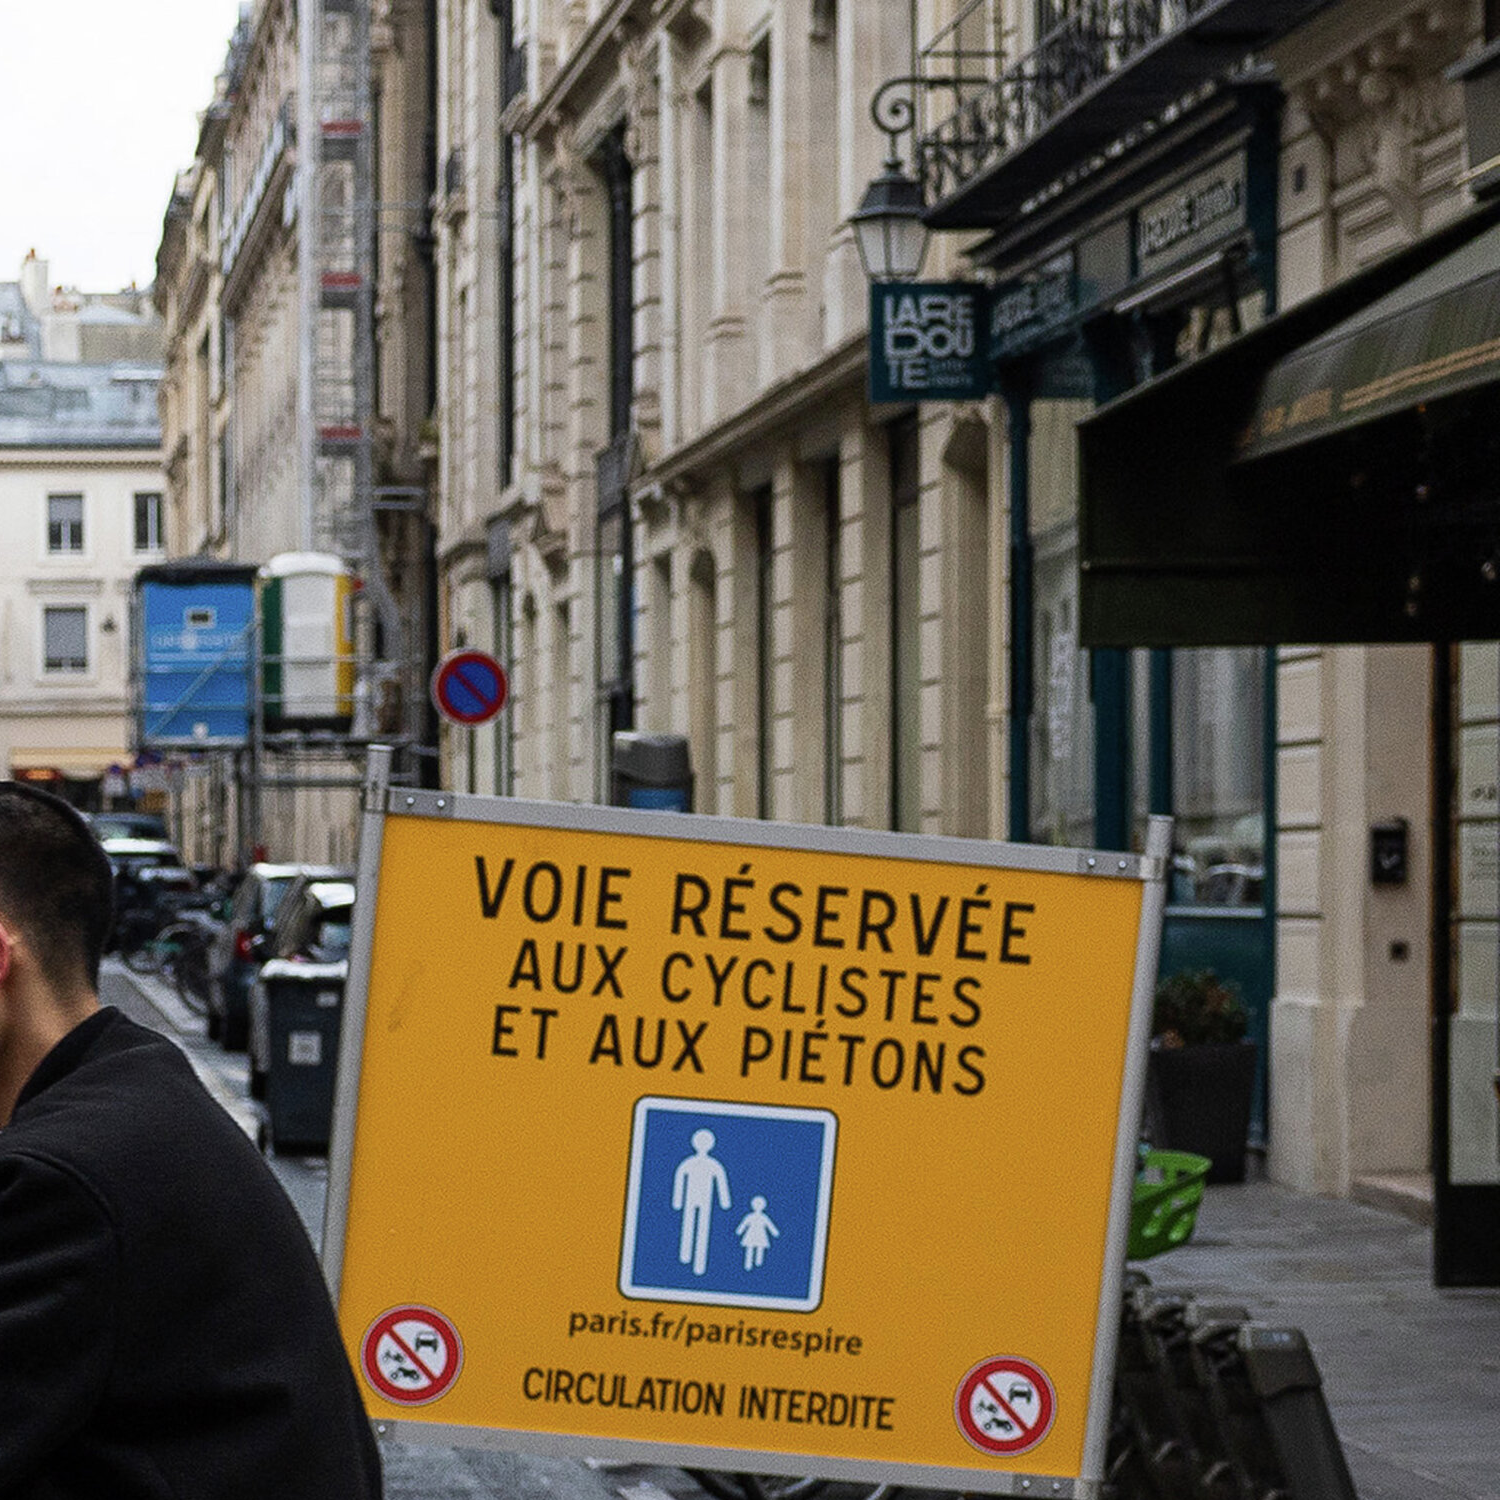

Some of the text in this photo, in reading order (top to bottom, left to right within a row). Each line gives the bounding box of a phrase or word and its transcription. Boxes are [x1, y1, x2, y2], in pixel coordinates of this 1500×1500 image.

[474, 855, 1036, 966] VOIE RÉSERVÉE
[508, 938, 981, 1028] AUX CYCLISTES
[491, 1004, 986, 1097] ET AUX PIÉTONS
[568, 1312, 863, 1357] paris.fr/parisrespire
[523, 1367, 895, 1431] CIRCULATION INTERDITE
